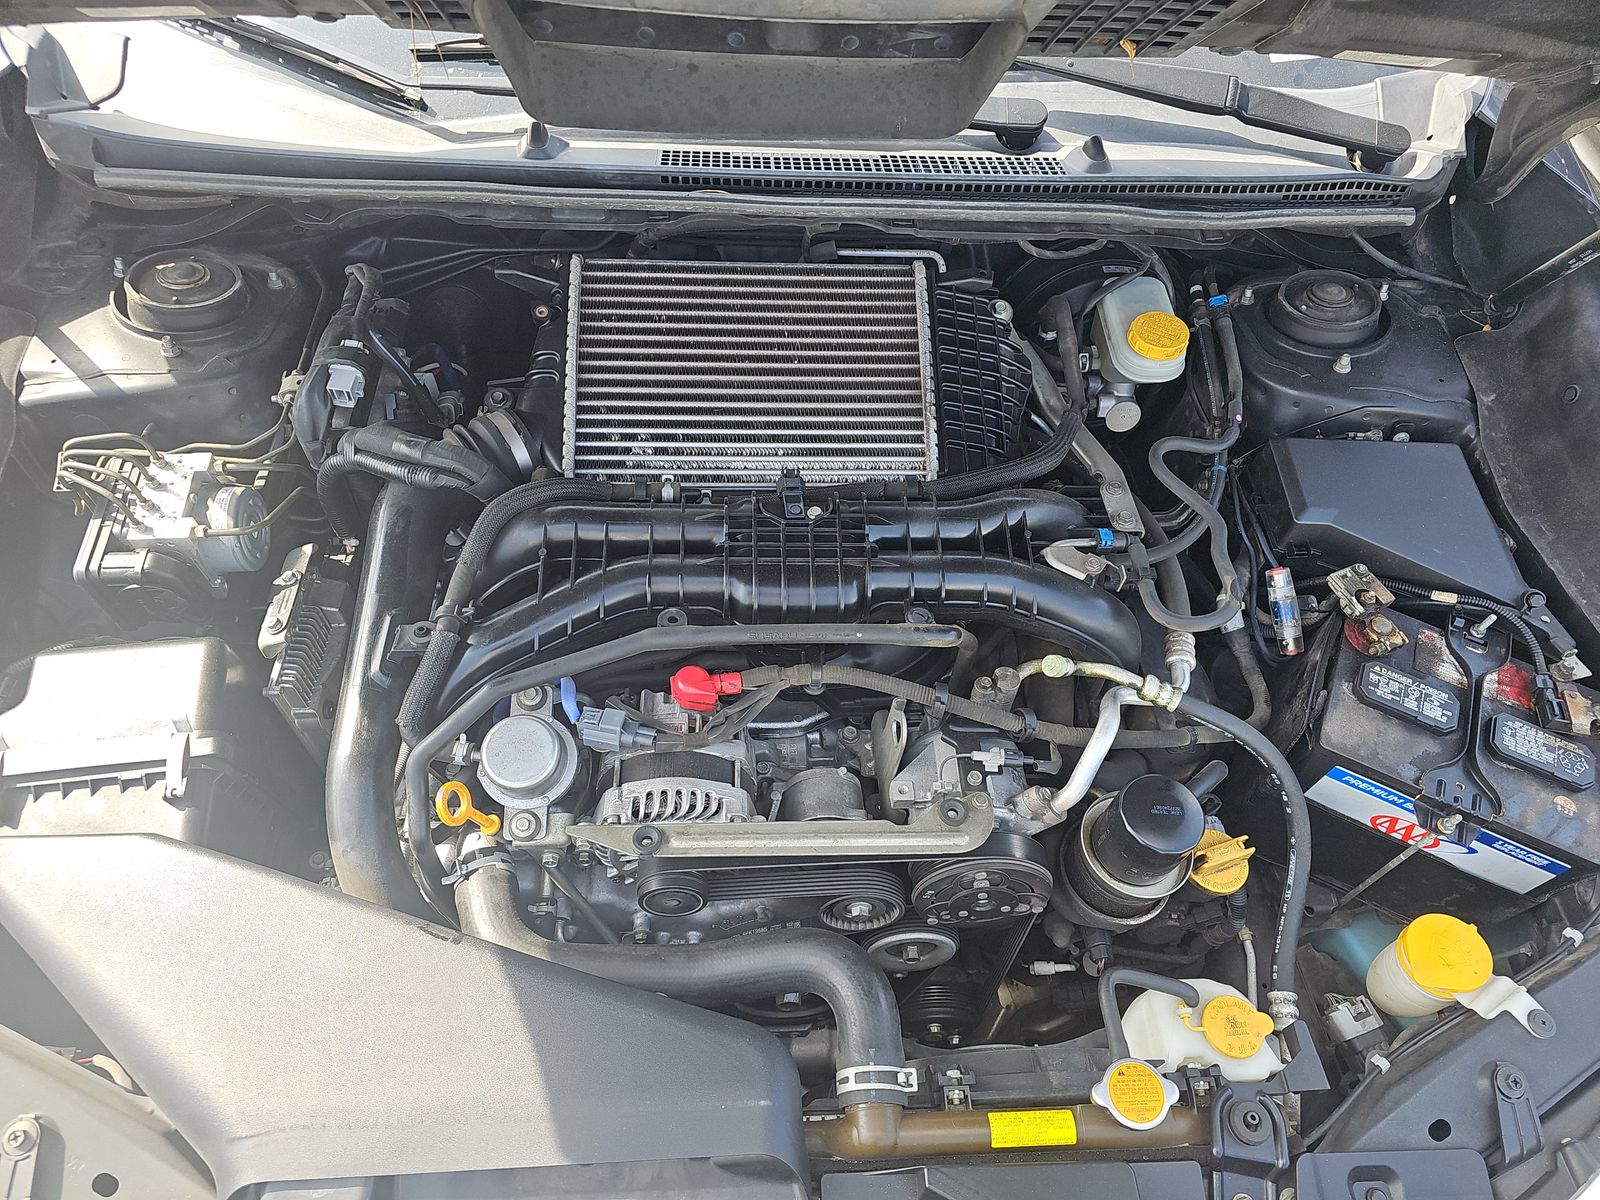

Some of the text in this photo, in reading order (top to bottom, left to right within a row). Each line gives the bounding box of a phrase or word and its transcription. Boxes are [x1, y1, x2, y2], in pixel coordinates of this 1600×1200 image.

[1381, 667, 1413, 687] DANGER
[1419, 683, 1449, 700] POISON
[1342, 775, 1405, 805] PREMIUM
[1502, 842, 1527, 856] YEAR
[1525, 852, 1552, 866] FREE
